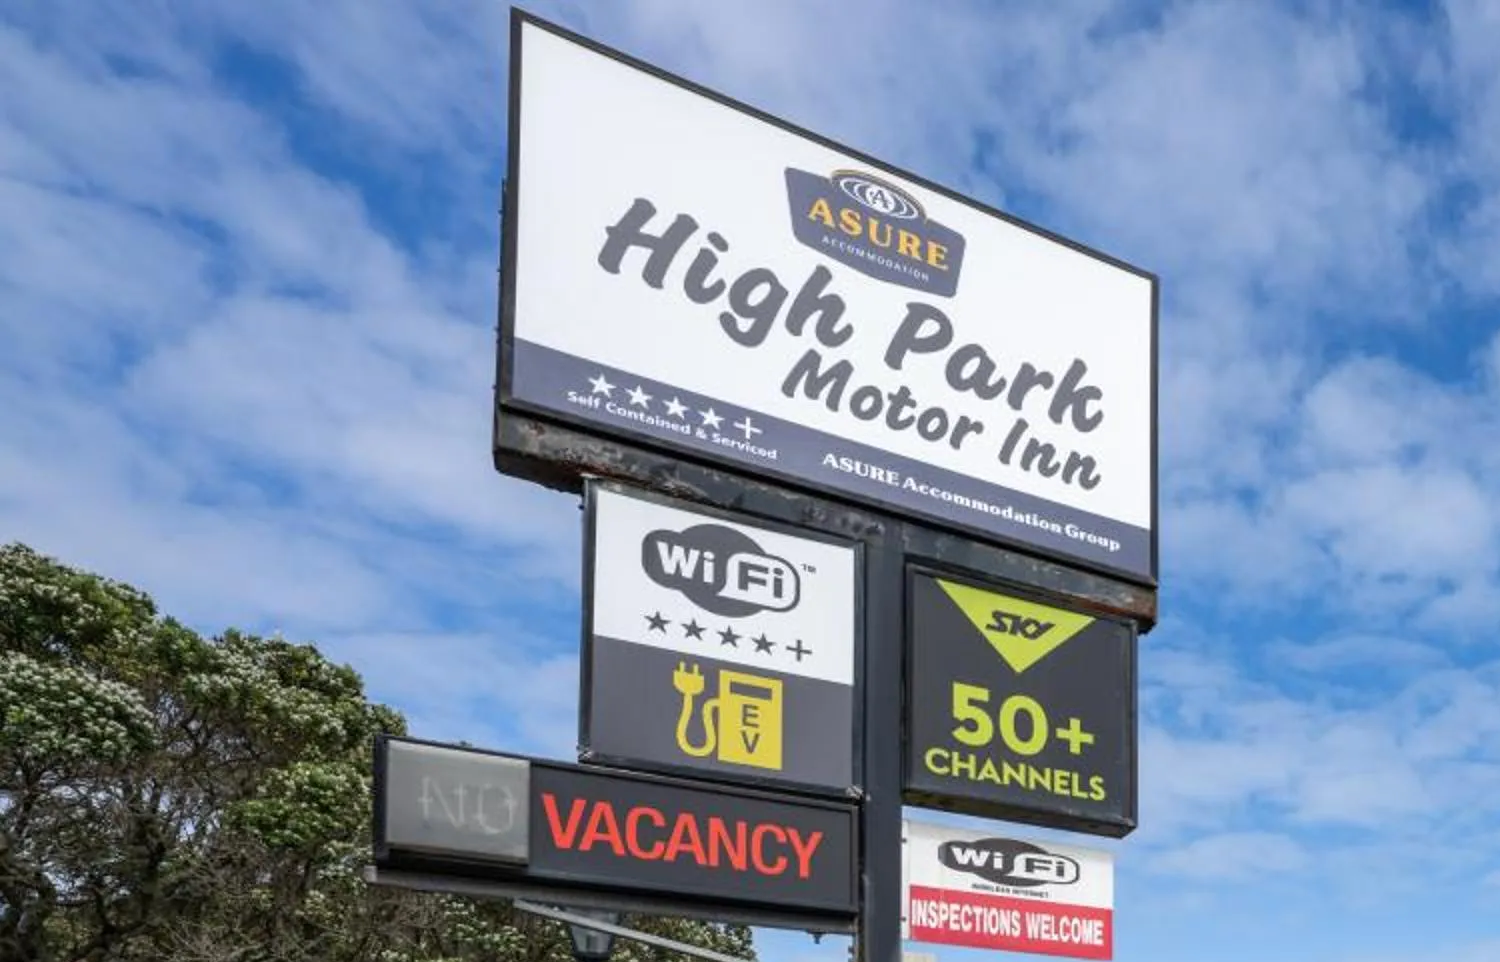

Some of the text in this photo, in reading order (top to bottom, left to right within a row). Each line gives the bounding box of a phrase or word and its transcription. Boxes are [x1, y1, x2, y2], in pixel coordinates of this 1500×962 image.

[808, 197, 949, 271] ASURE
[821, 235, 929, 282] ACCOMMODATION
[597, 197, 1105, 433] High Park
[567, 391, 778, 460] Self Contained & Serviced
[780, 348, 1102, 491] Motor Inn
[822, 452, 1121, 552] ASURE Accommodation Group
[985, 610, 1056, 640] SKY
[952, 681, 1095, 755] 50+
[925, 747, 1106, 801] CHANNELS
[418, 775, 824, 879] NO VACANCY
[911, 899, 1104, 946] INSPECTIONS WELCOME
